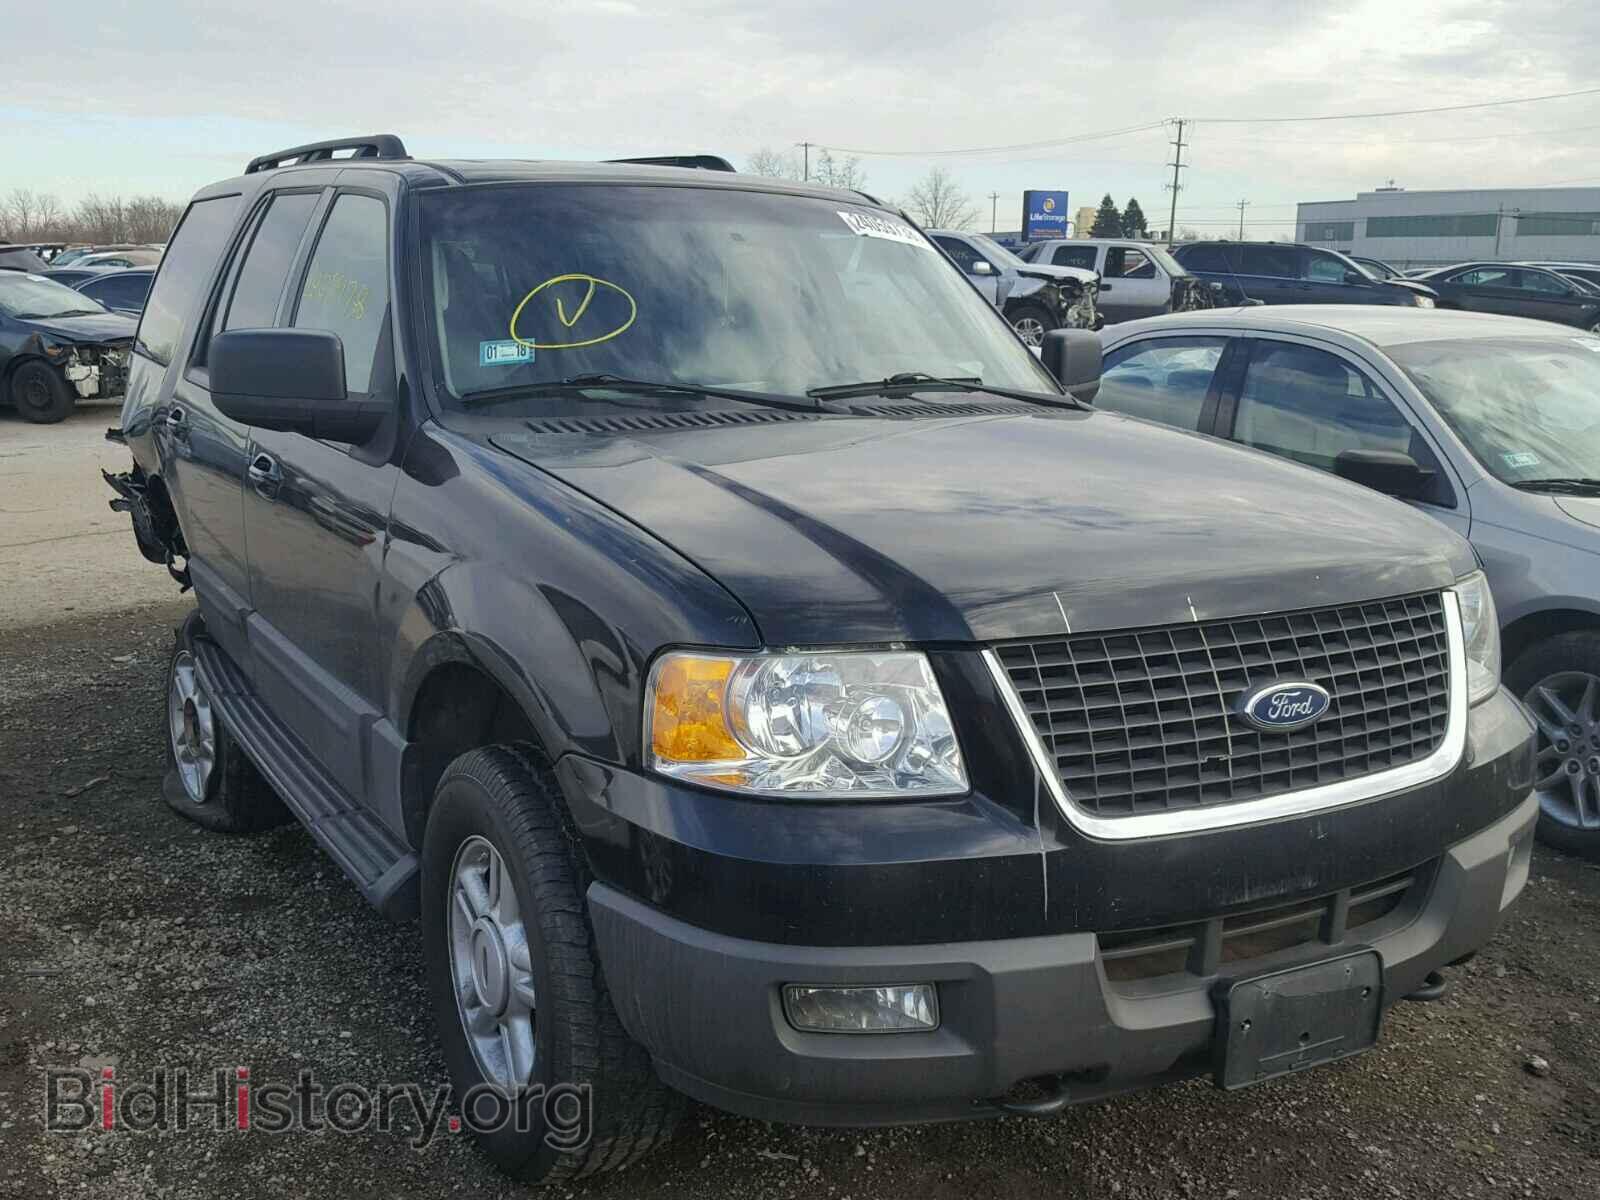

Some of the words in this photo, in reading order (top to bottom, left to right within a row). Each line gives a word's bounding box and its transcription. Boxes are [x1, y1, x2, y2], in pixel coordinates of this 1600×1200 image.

[486, 345, 497, 360] 01
[516, 344, 527, 357] 18
[1268, 691, 1313, 719] Ford
